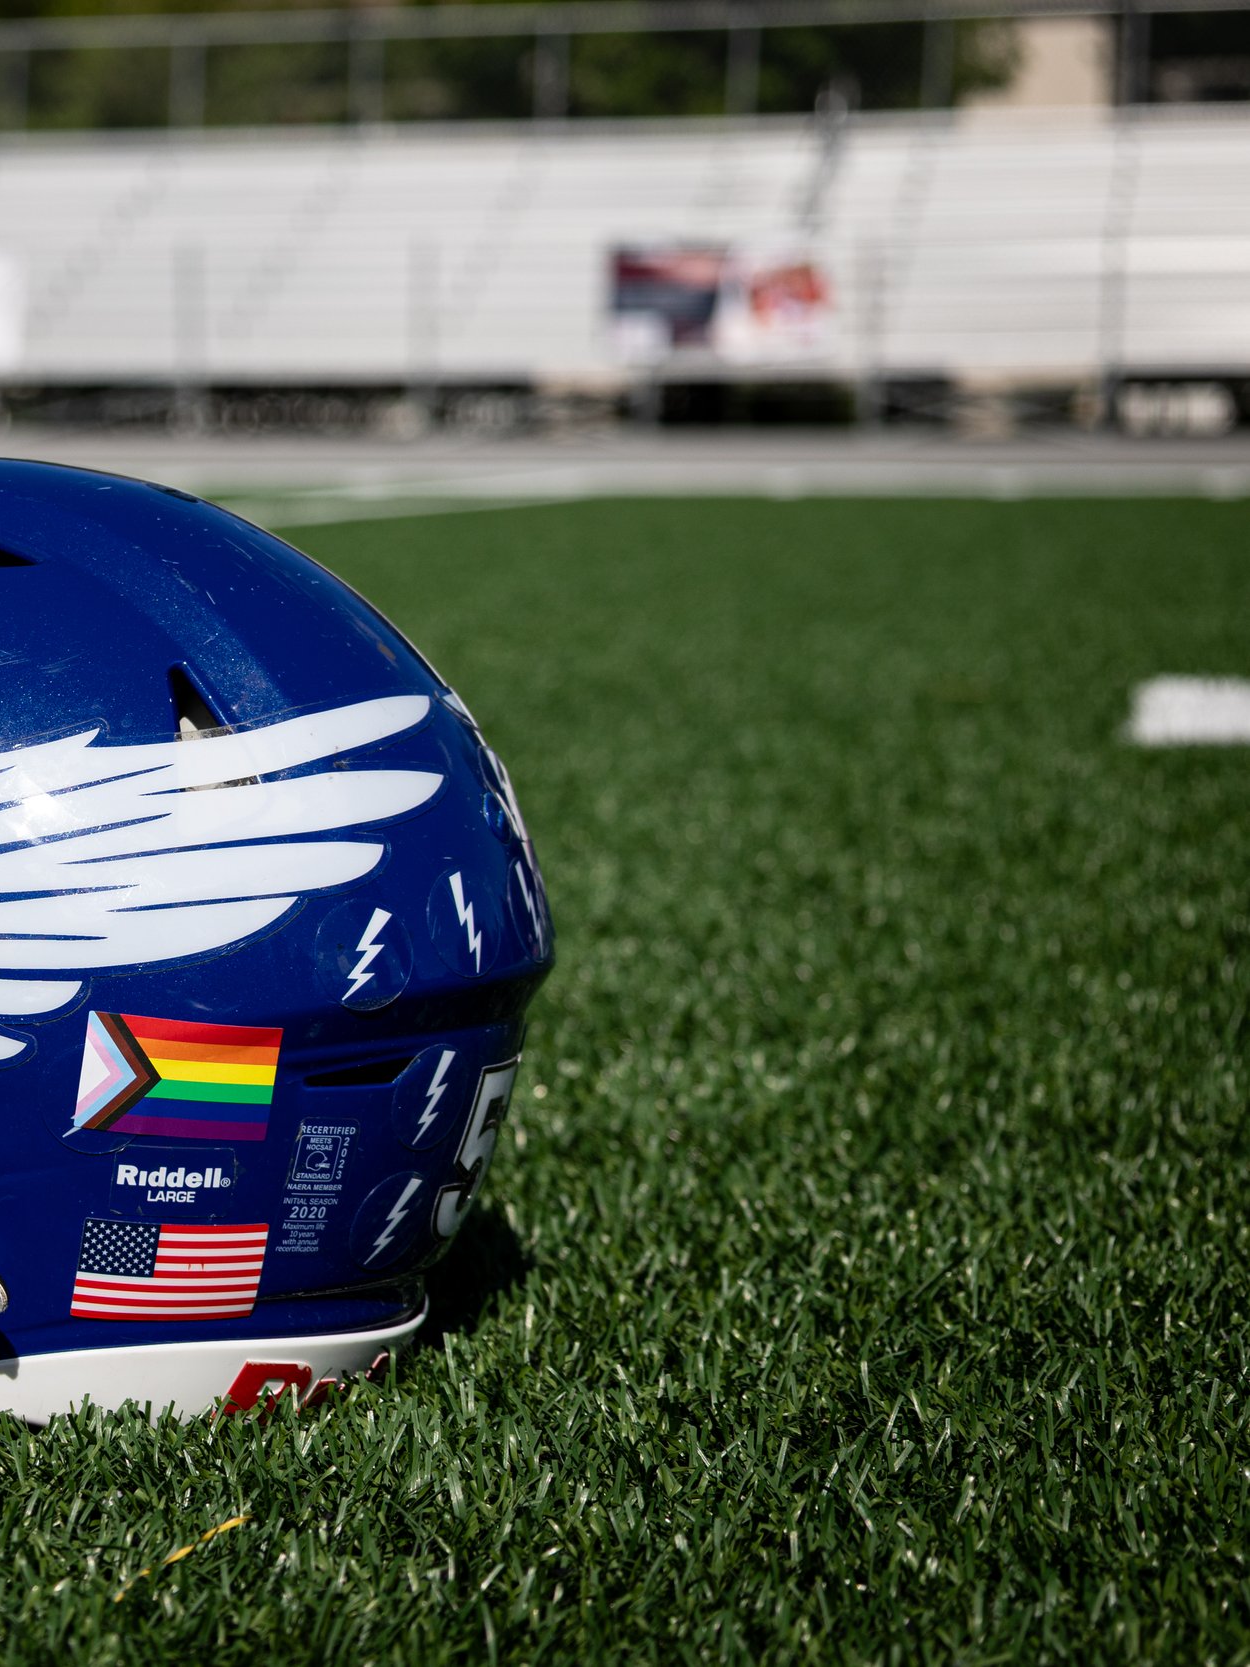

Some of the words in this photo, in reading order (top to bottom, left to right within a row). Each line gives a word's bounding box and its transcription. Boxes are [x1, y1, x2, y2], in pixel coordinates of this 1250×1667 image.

[301, 1125, 356, 1135] RECERTIFIED
[432, 1054, 521, 1243] 5
[295, 1172, 331, 1180] STANDARD
[286, 1183, 312, 1191] NAERA
[147, 1190, 196, 1203] LARGE
[283, 1197, 307, 1205] INITIAL
[309, 1198, 339, 1206] SEASON
[289, 1205, 327, 1219] 2020
[282, 1222, 315, 1230] Maximum
[315, 1223, 326, 1231] life
[289, 1230, 298, 1238] 10
[298, 1231, 316, 1239] years
[297, 1238, 320, 1246] annual
[275, 1245, 319, 1253] recertification
